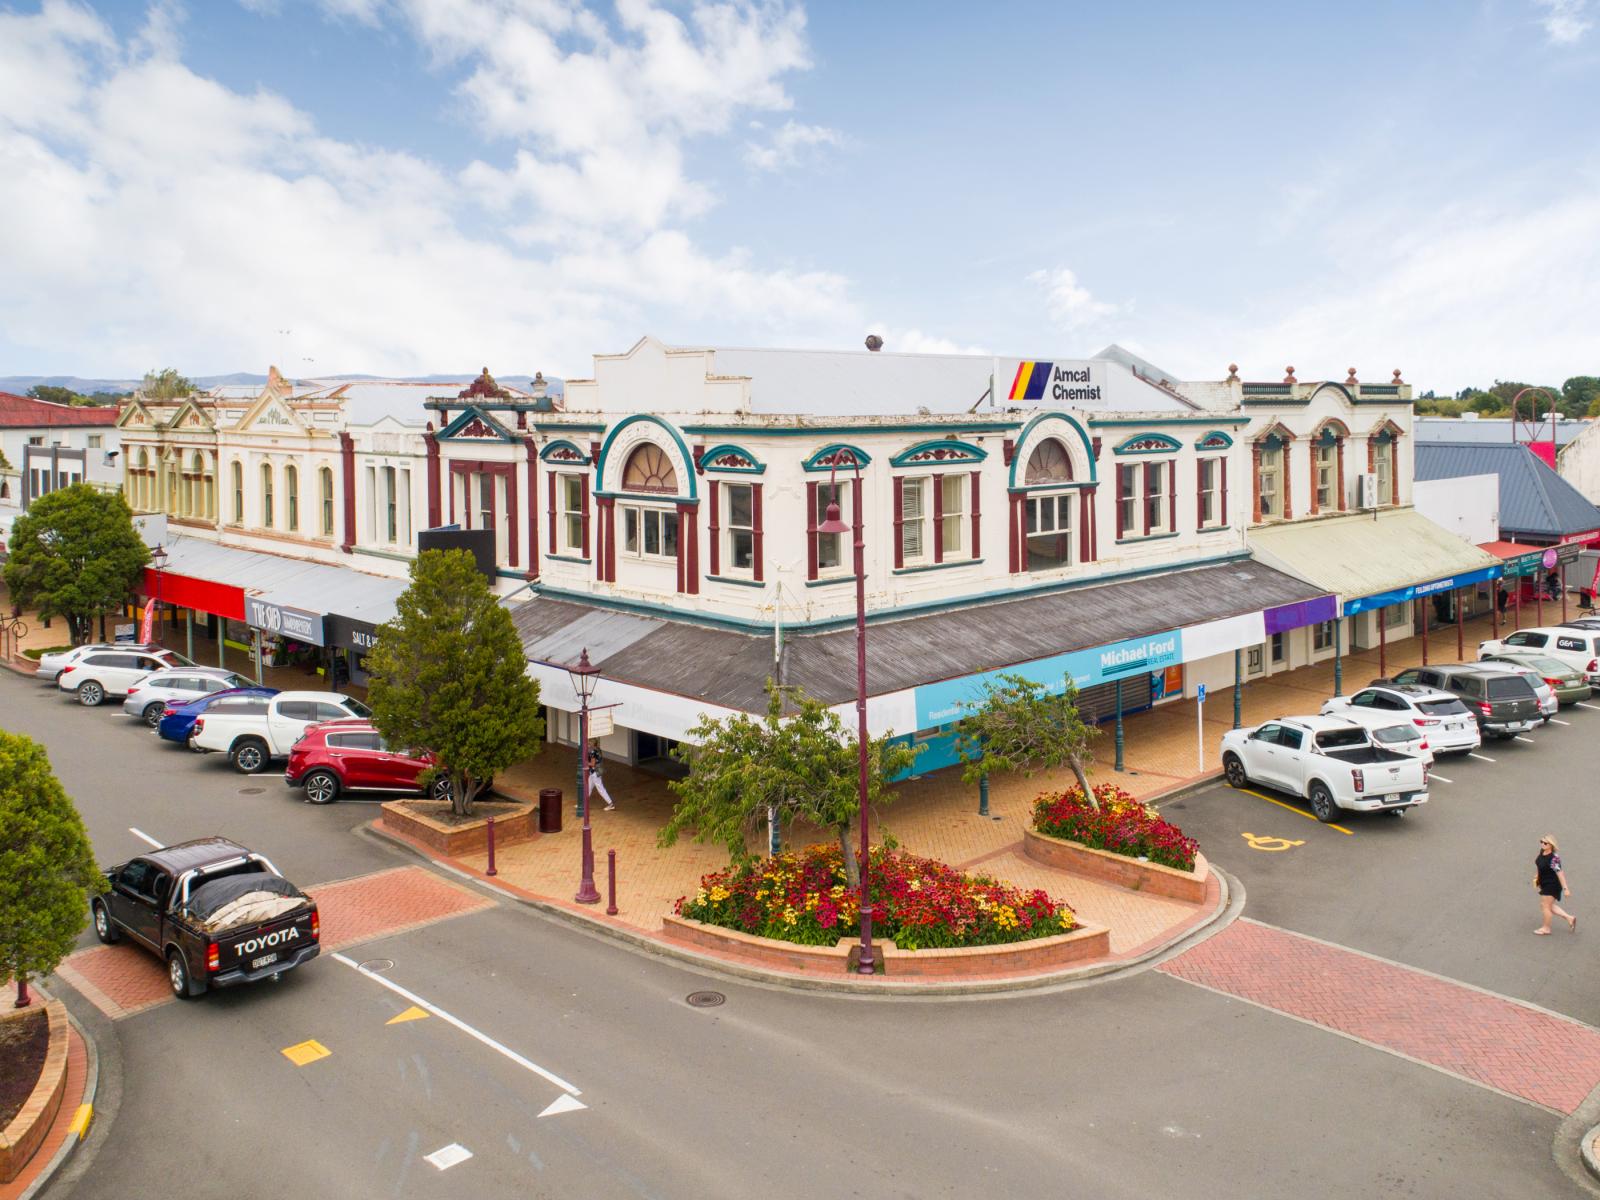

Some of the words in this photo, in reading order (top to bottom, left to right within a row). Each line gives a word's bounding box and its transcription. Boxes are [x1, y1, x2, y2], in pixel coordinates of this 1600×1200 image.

[1053, 366, 1090, 382] Amcal
[1052, 384, 1101, 400] Chemist
[252, 602, 266, 627] THE
[266, 606, 282, 631] SHED
[352, 631, 366, 646] SALT
[1101, 643, 1147, 667] Michael
[1149, 638, 1175, 657] Ford
[234, 927, 300, 956] TOYOTA
